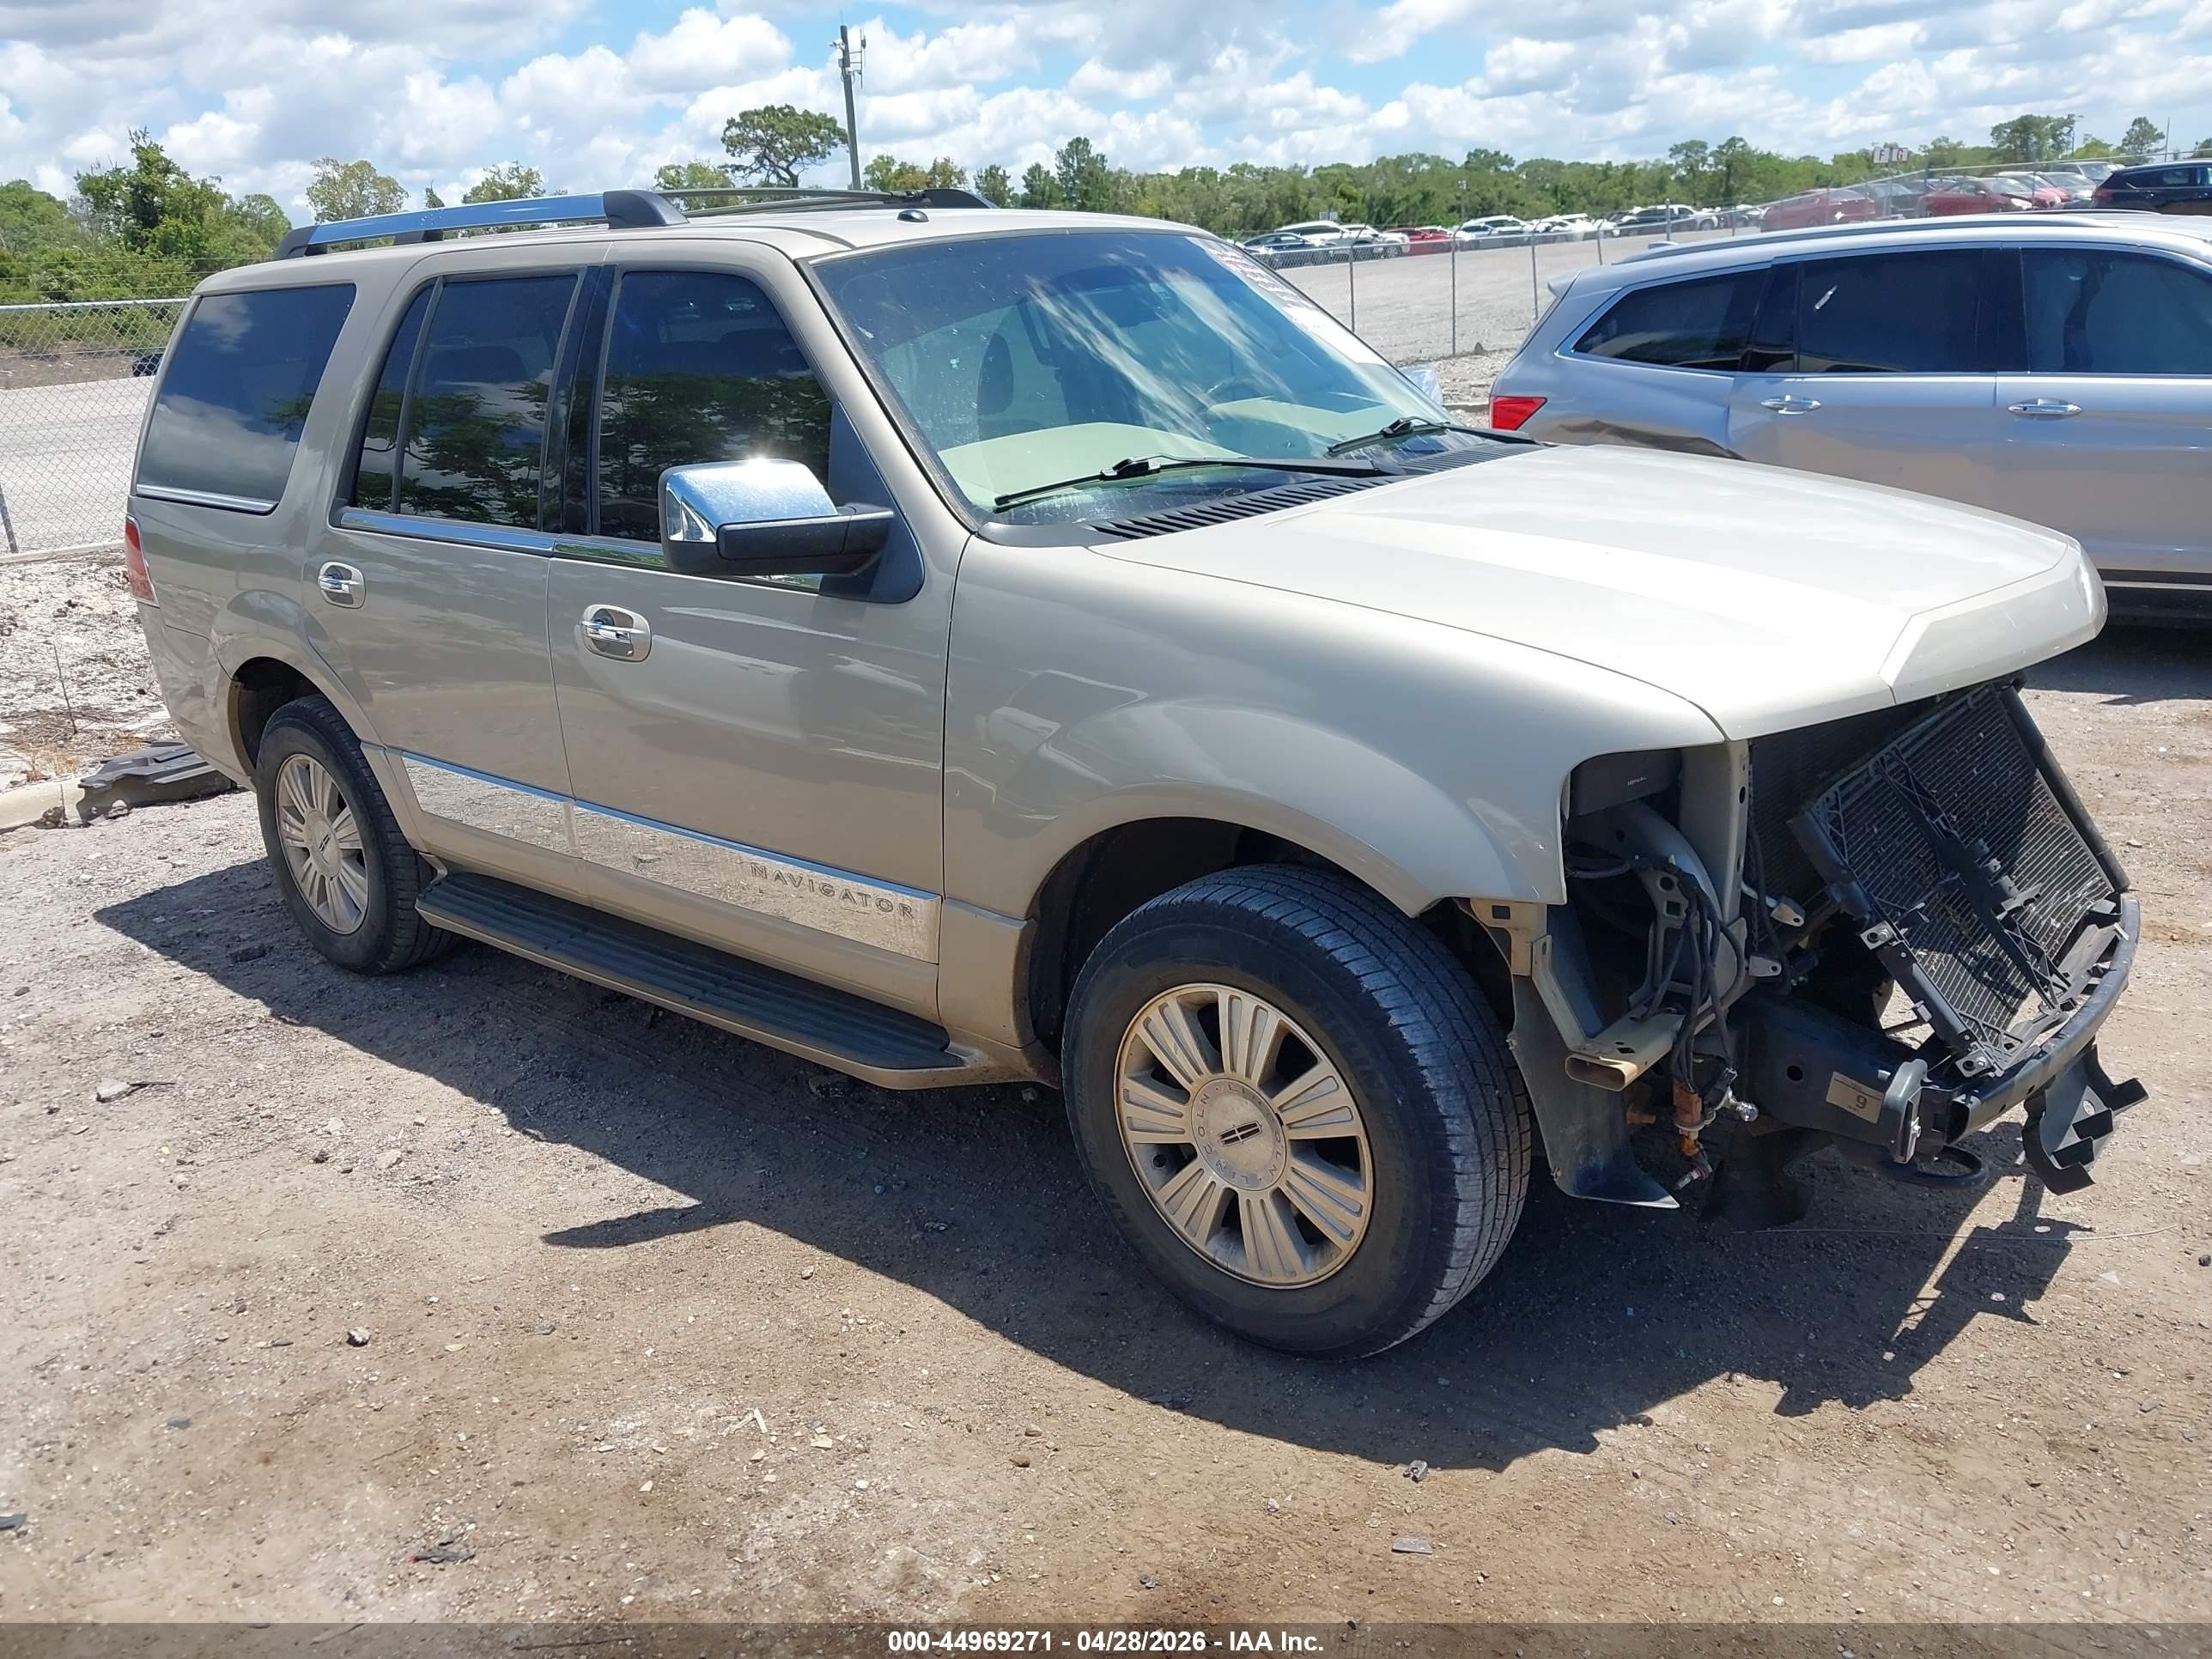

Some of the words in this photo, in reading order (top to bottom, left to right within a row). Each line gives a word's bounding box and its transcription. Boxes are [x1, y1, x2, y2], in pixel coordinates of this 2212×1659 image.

[750, 862, 915, 920] NAVIGATOR
[1856, 1095, 1867, 1109] 9
[1196, 1093, 1249, 1184] LINCOLN
